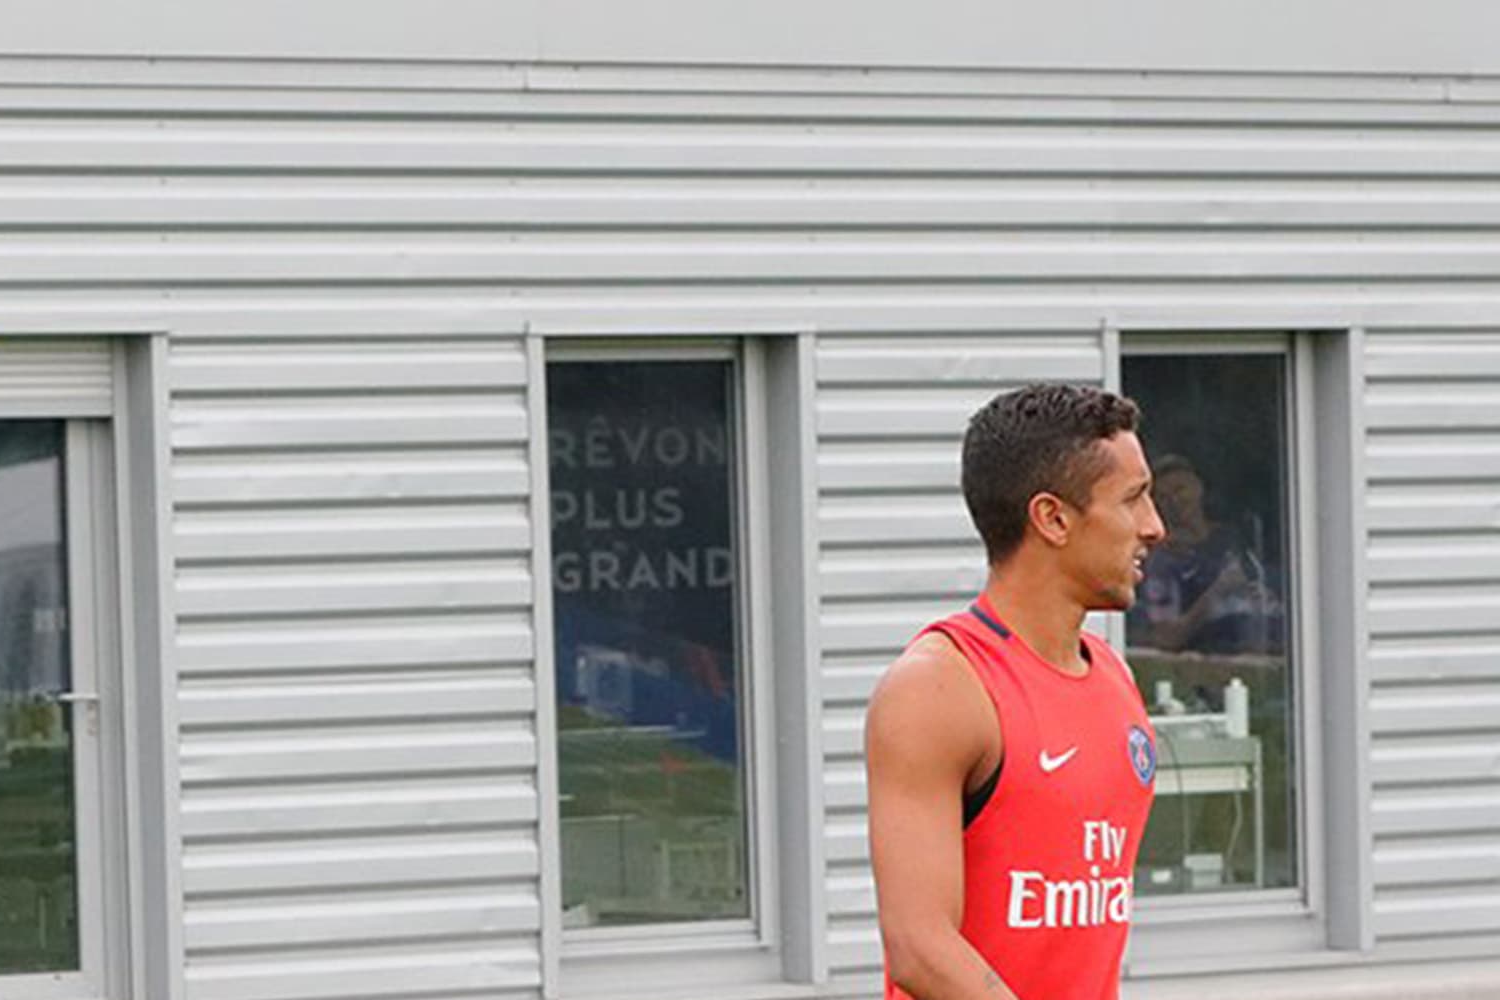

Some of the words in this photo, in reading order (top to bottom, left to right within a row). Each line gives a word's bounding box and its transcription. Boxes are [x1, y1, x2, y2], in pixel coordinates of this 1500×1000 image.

[549, 487, 685, 530] PLUS
[553, 547, 735, 593] GRAND
[1083, 821, 1127, 867] Fly
[1006, 865, 1133, 928] Emira
